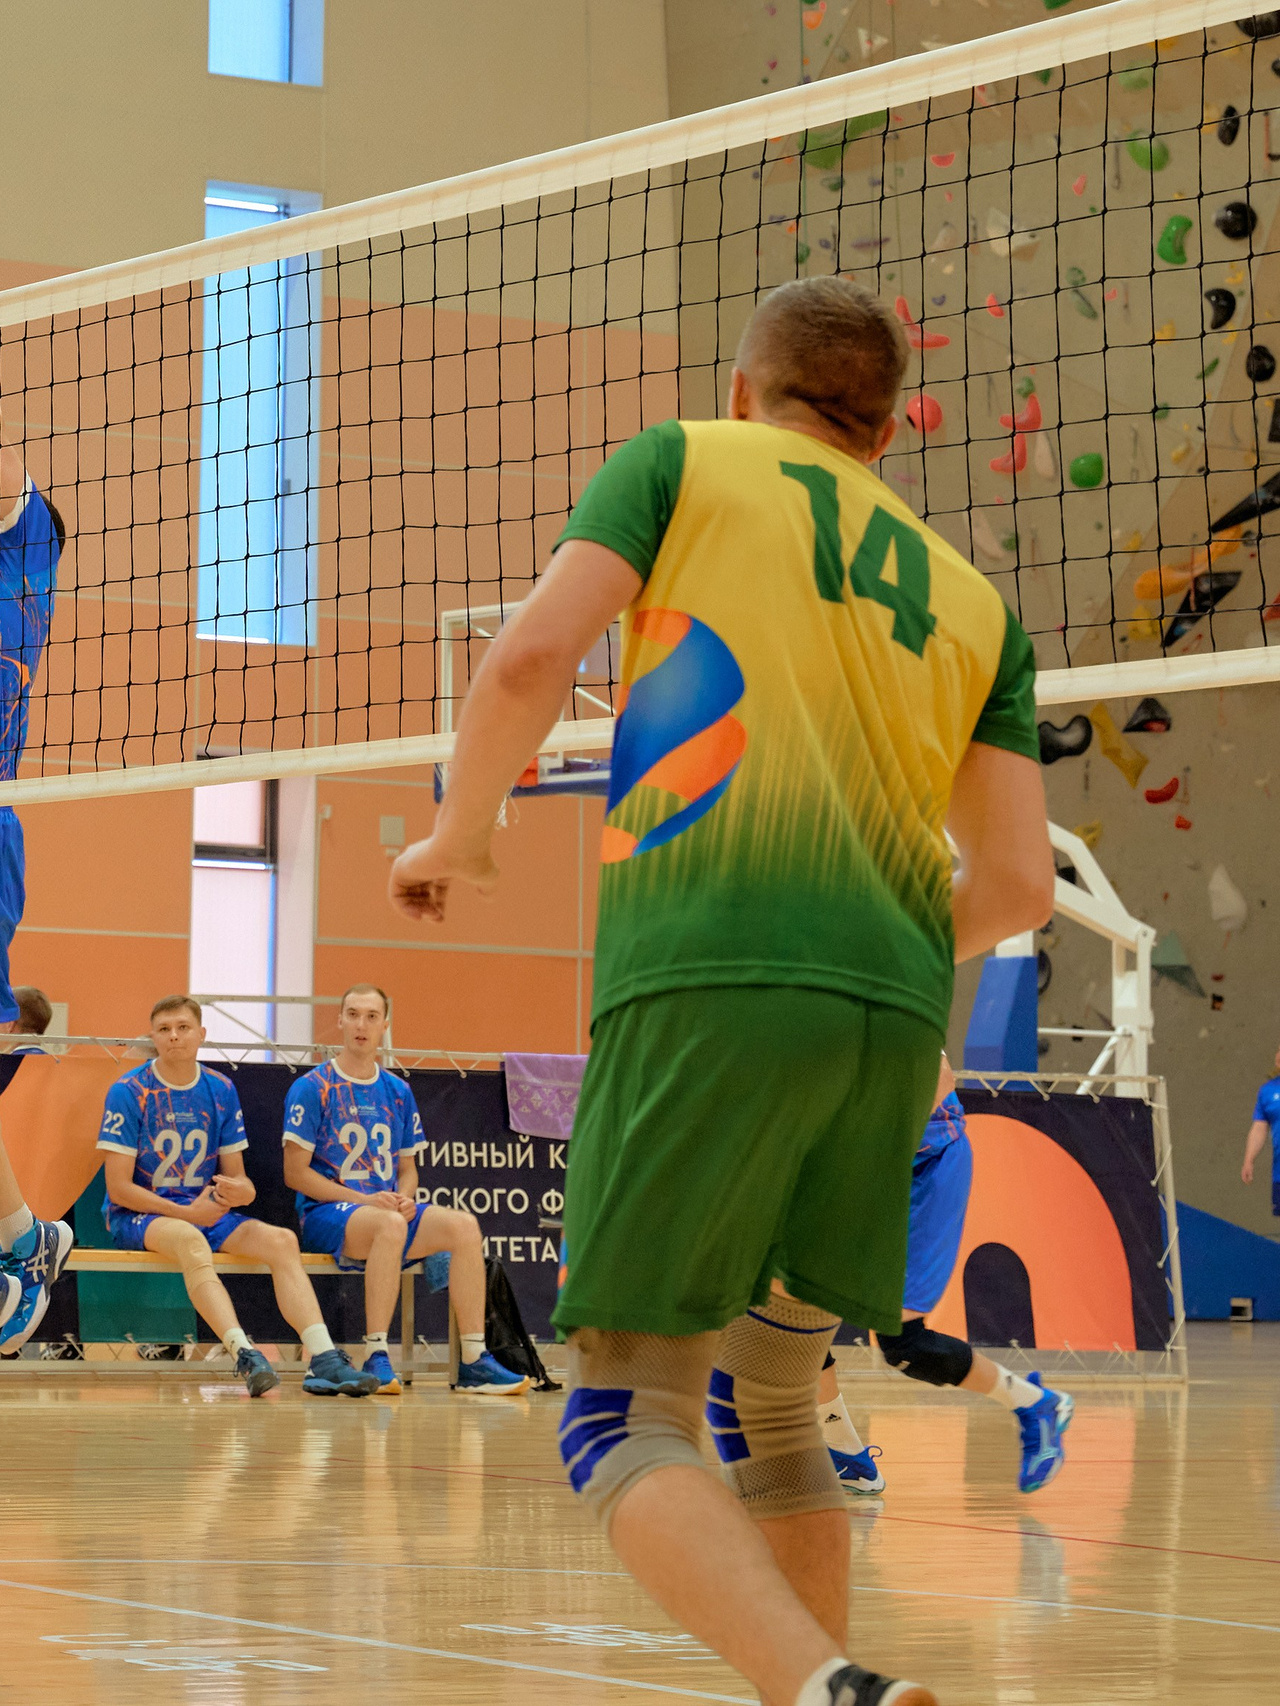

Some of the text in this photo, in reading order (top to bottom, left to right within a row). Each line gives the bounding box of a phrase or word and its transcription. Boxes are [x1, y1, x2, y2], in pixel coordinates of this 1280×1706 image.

[778, 460, 938, 660] 14
[289, 1104, 305, 1127] 3
[152, 1128, 209, 1188] 22
[338, 1122, 394, 1182] 23
